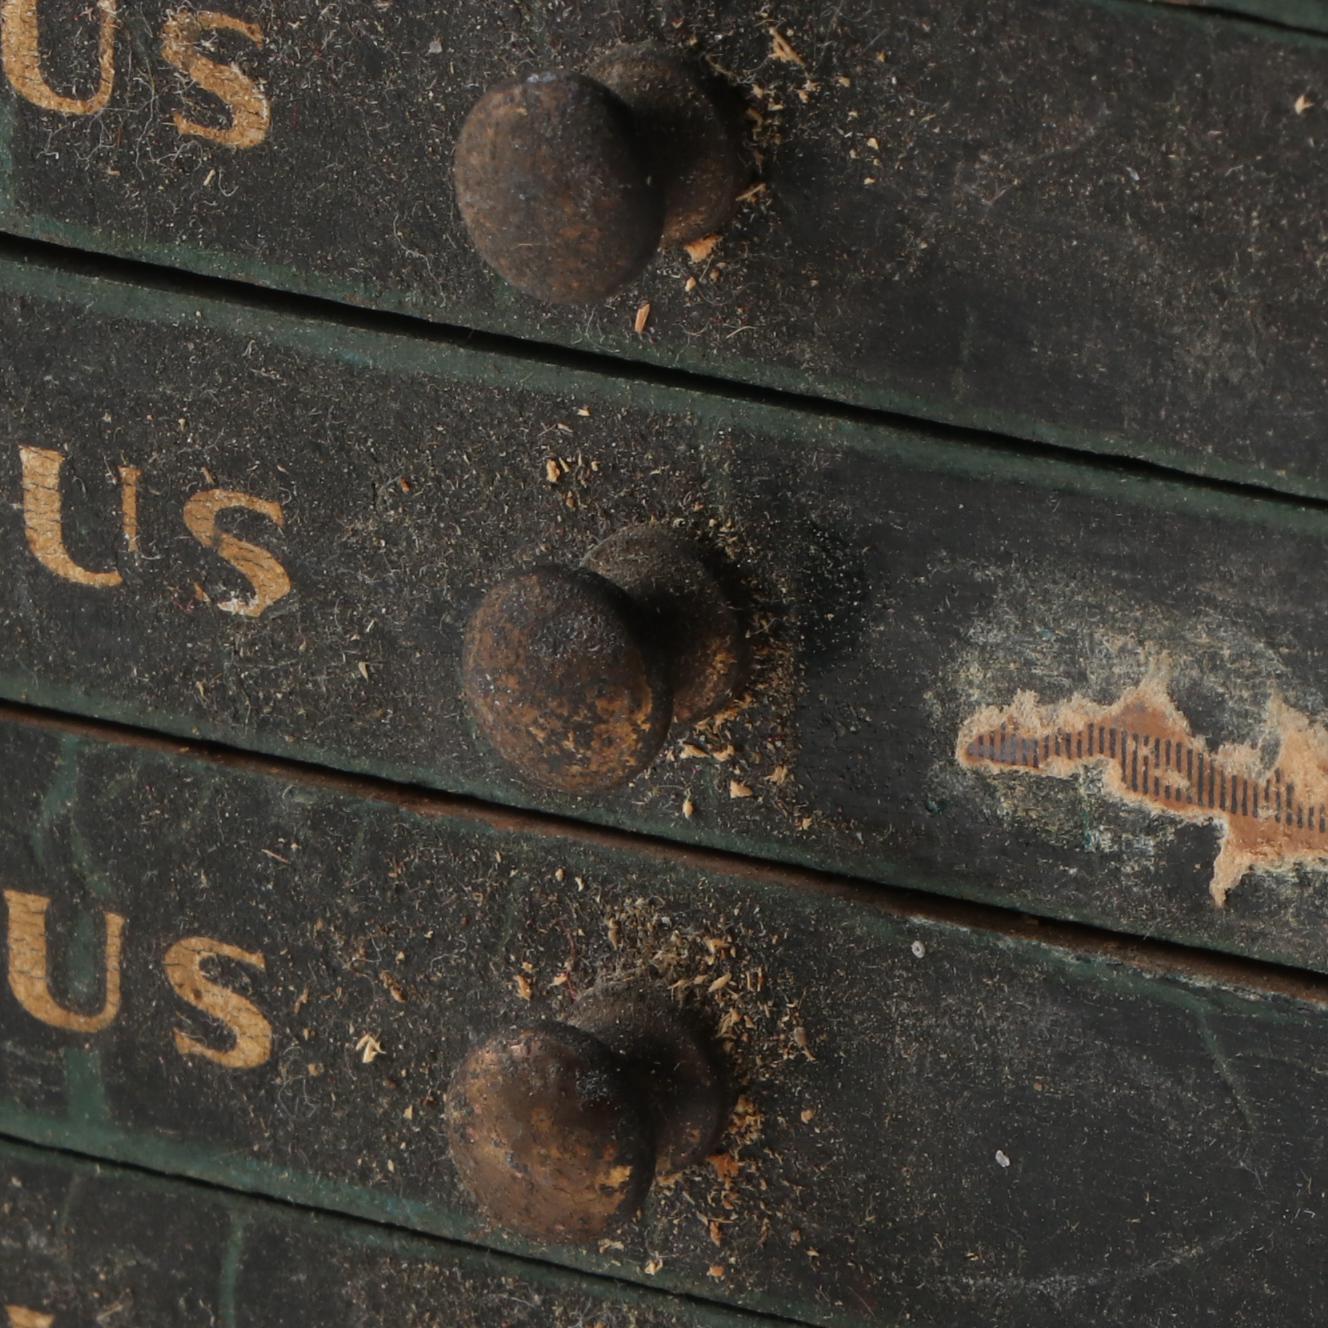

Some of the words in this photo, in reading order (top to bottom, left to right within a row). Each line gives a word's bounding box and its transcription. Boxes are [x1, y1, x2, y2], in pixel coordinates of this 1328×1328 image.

[1, 0, 270, 148] US
[19, 444, 291, 617] US
[4, 888, 273, 1069] US
